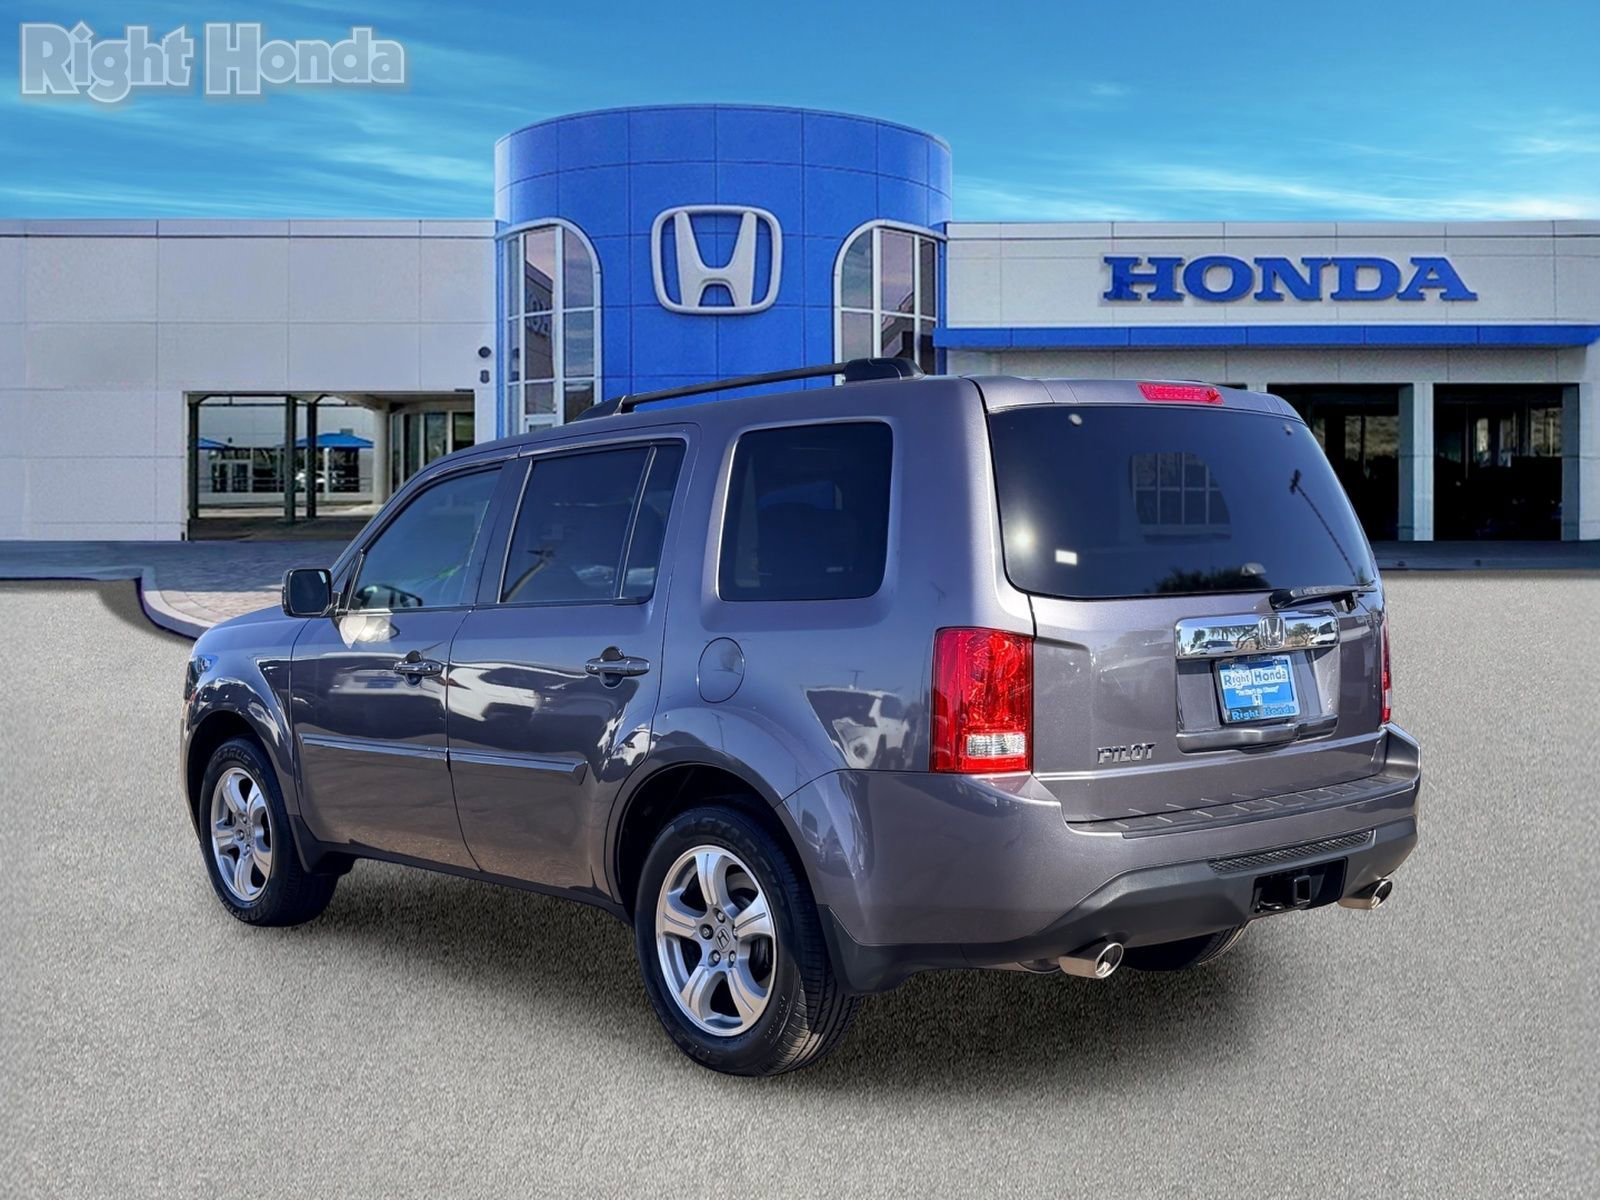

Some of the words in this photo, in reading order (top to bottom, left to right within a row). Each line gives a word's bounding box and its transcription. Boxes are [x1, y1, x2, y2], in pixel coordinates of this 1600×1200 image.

[1103, 255, 1478, 302] HONDA
[1223, 671, 1250, 687] Right
[1254, 669, 1287, 682] Honda
[1231, 709, 1260, 720] Right
[1263, 704, 1296, 716] Honda
[1096, 743, 1156, 765] PILOT
